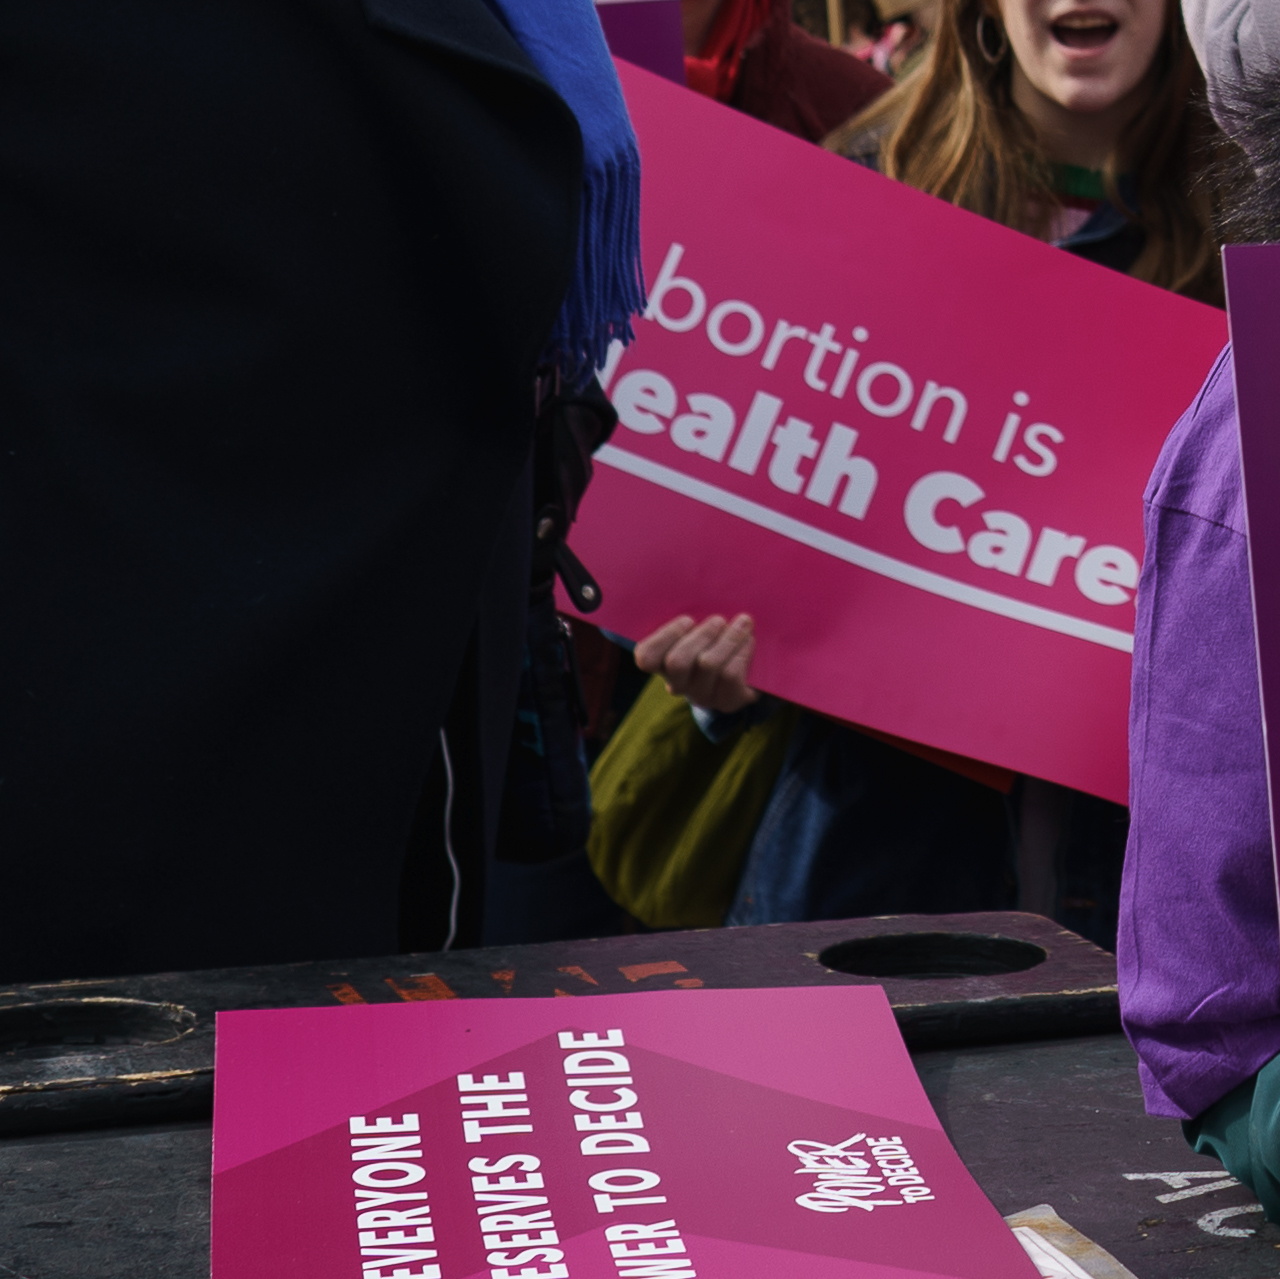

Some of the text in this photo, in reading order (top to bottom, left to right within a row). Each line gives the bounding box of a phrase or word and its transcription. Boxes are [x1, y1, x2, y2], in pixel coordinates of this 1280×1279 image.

[992, 390, 1066, 478] is
[903, 470, 1139, 607] Care
[558, 1028, 651, 1156] DECIDE
[349, 1113, 442, 1279] EVERYONE
[457, 1071, 570, 1279] ESERVES THE
[588, 1168, 667, 1214] TO
[865, 1136, 935, 1204] TO DECIDE
